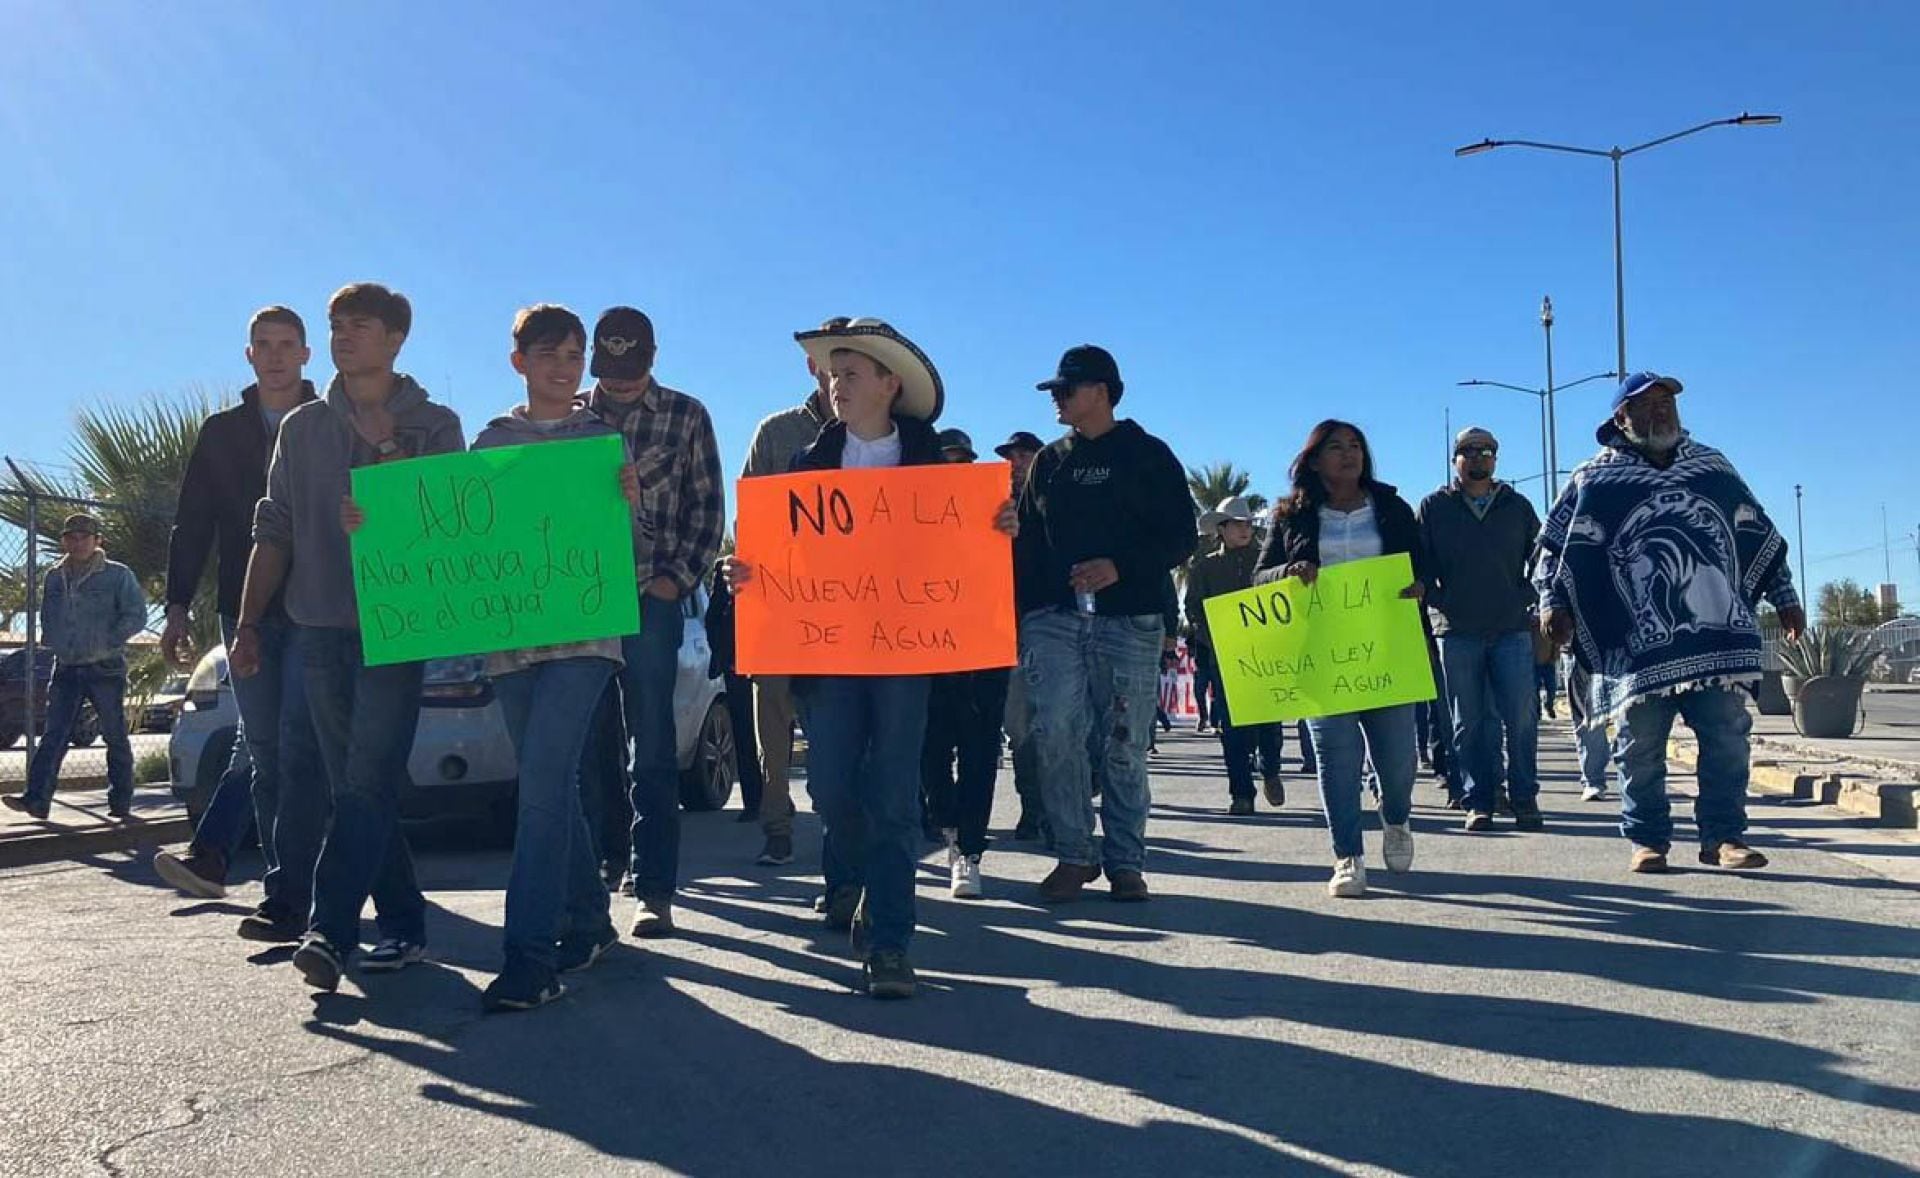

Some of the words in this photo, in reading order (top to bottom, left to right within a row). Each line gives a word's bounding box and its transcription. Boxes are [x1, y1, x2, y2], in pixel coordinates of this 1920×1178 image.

[418, 475, 494, 538] NO
[788, 484, 853, 536] NO
[869, 486, 892, 525] A
[914, 491, 962, 528] LA
[426, 549, 525, 587] nueva
[533, 515, 605, 616] Ley
[758, 548, 880, 602] NUEVA
[896, 578, 960, 605] LEY
[375, 603, 421, 641] De
[437, 593, 459, 630] el
[471, 591, 543, 637] agua
[1238, 591, 1292, 627] NO
[1307, 580, 1324, 617] A
[1343, 577, 1371, 610] LA
[800, 619, 842, 646] DE
[870, 620, 957, 651] AGUA
[1238, 645, 1315, 679] NUEVA
[1330, 641, 1374, 664] LEY
[1269, 688, 1298, 705] DE
[1333, 672, 1393, 695] AGUA
